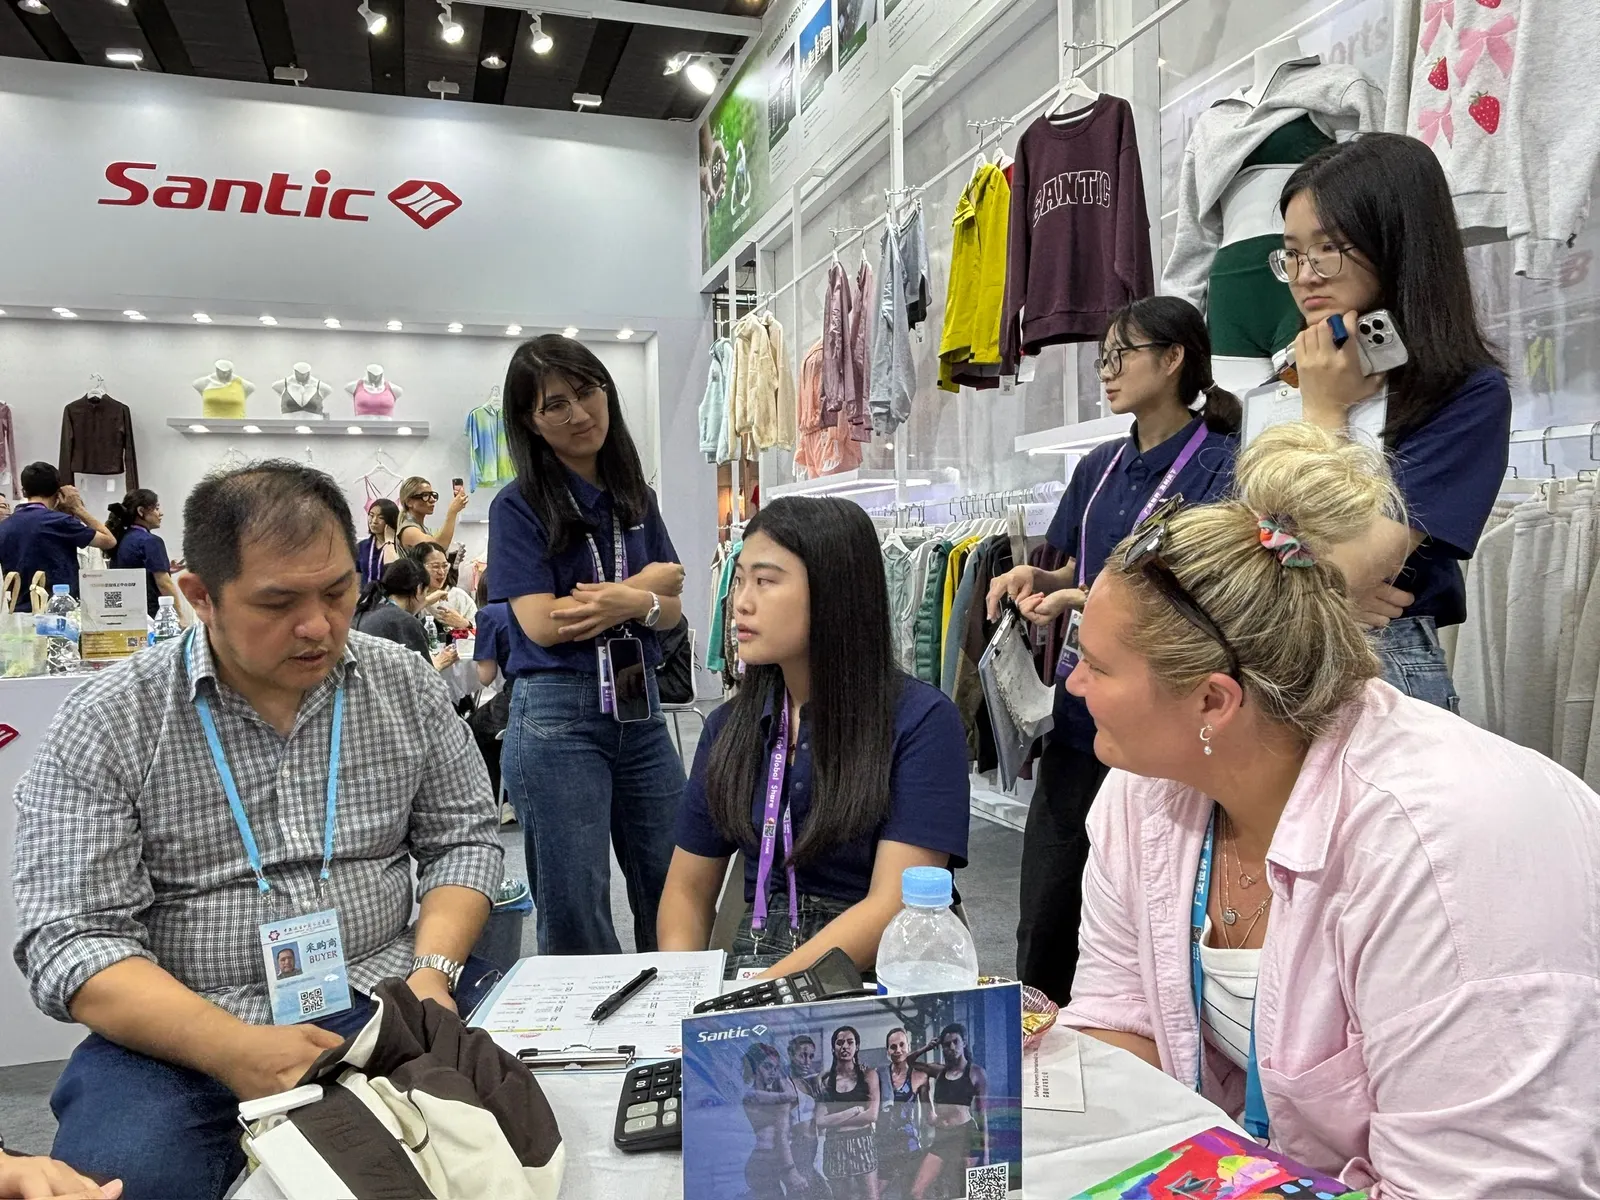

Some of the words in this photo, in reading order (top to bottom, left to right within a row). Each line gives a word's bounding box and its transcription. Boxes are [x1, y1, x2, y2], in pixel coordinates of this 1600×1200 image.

[97, 161, 376, 222] Santic
[772, 753, 783, 780] Global
[768, 784, 779, 809] Share
[306, 938, 337, 953] 采购商
[309, 951, 338, 963] BUYER
[697, 1026, 750, 1043] Santic
